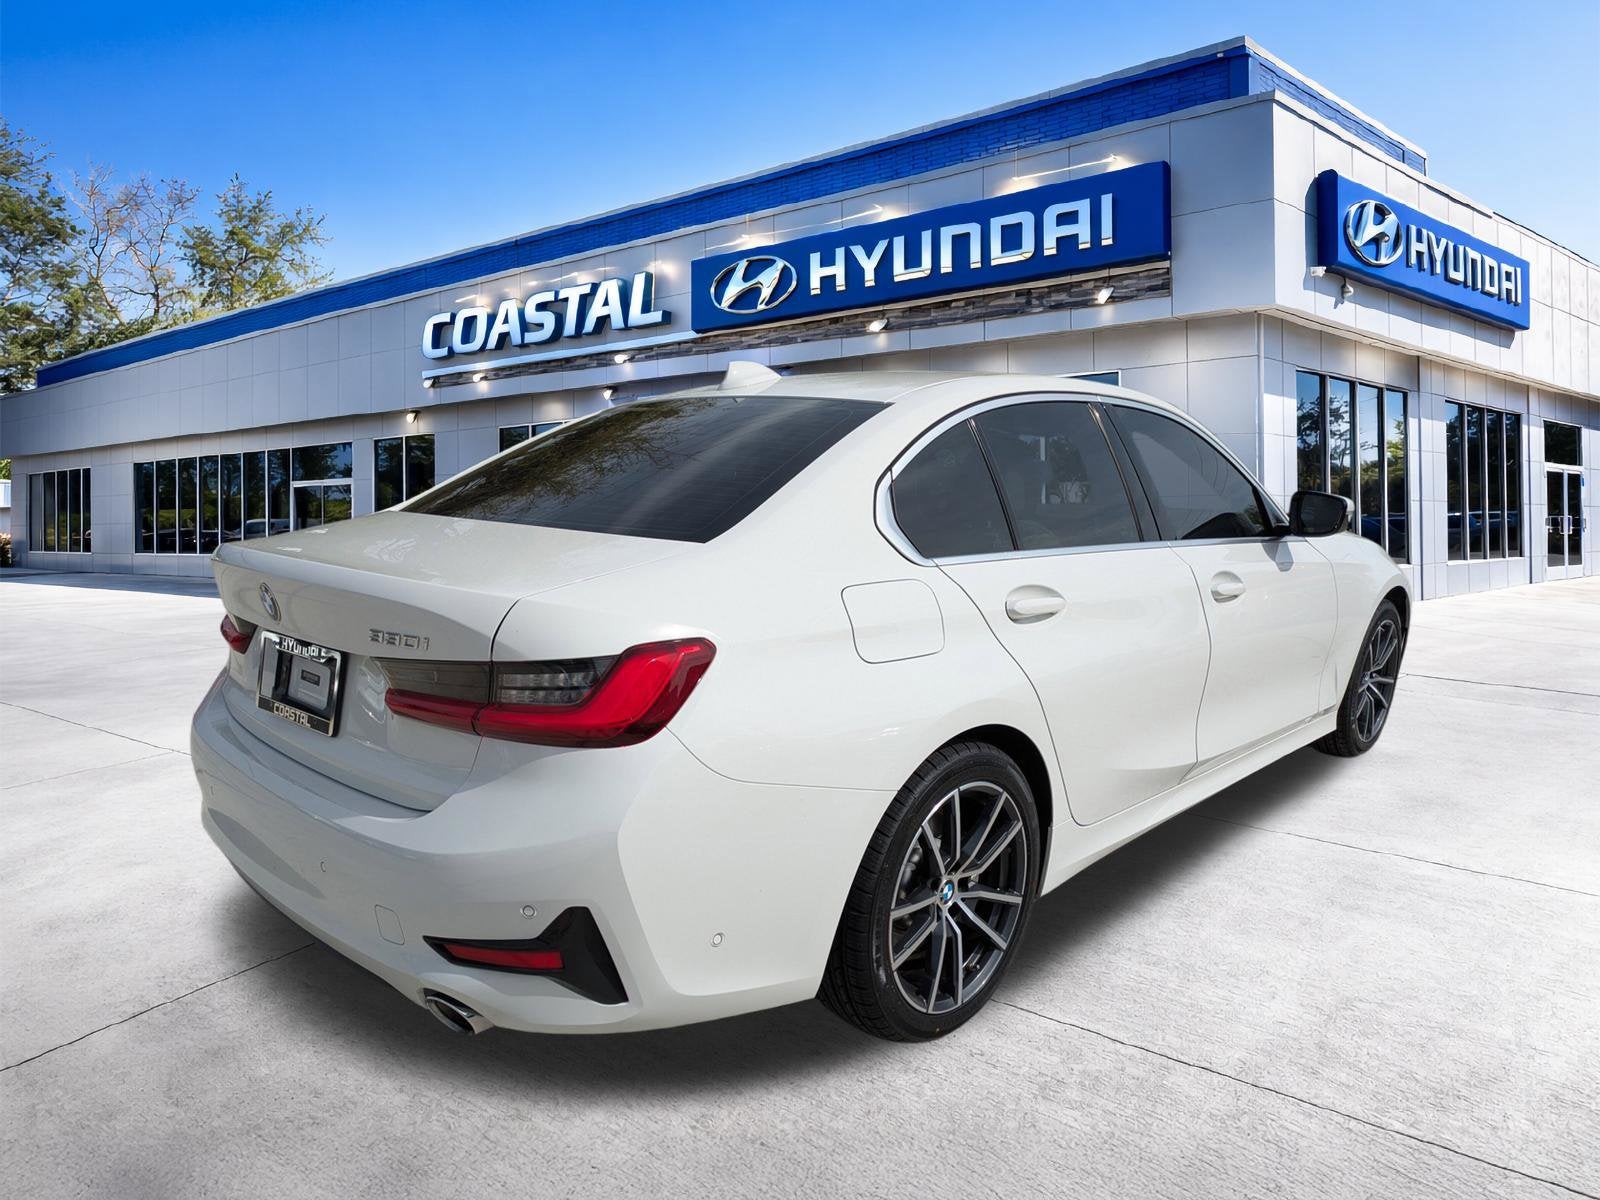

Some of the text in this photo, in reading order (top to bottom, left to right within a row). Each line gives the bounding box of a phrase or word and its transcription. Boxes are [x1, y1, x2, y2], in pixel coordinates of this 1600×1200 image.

[808, 192, 1114, 295] HYUNDAI
[1406, 224, 1522, 306] HYUNDAI
[421, 270, 667, 360] COASTAL
[281, 637, 319, 657] HYUNDAI
[273, 702, 311, 728] COASTAL
